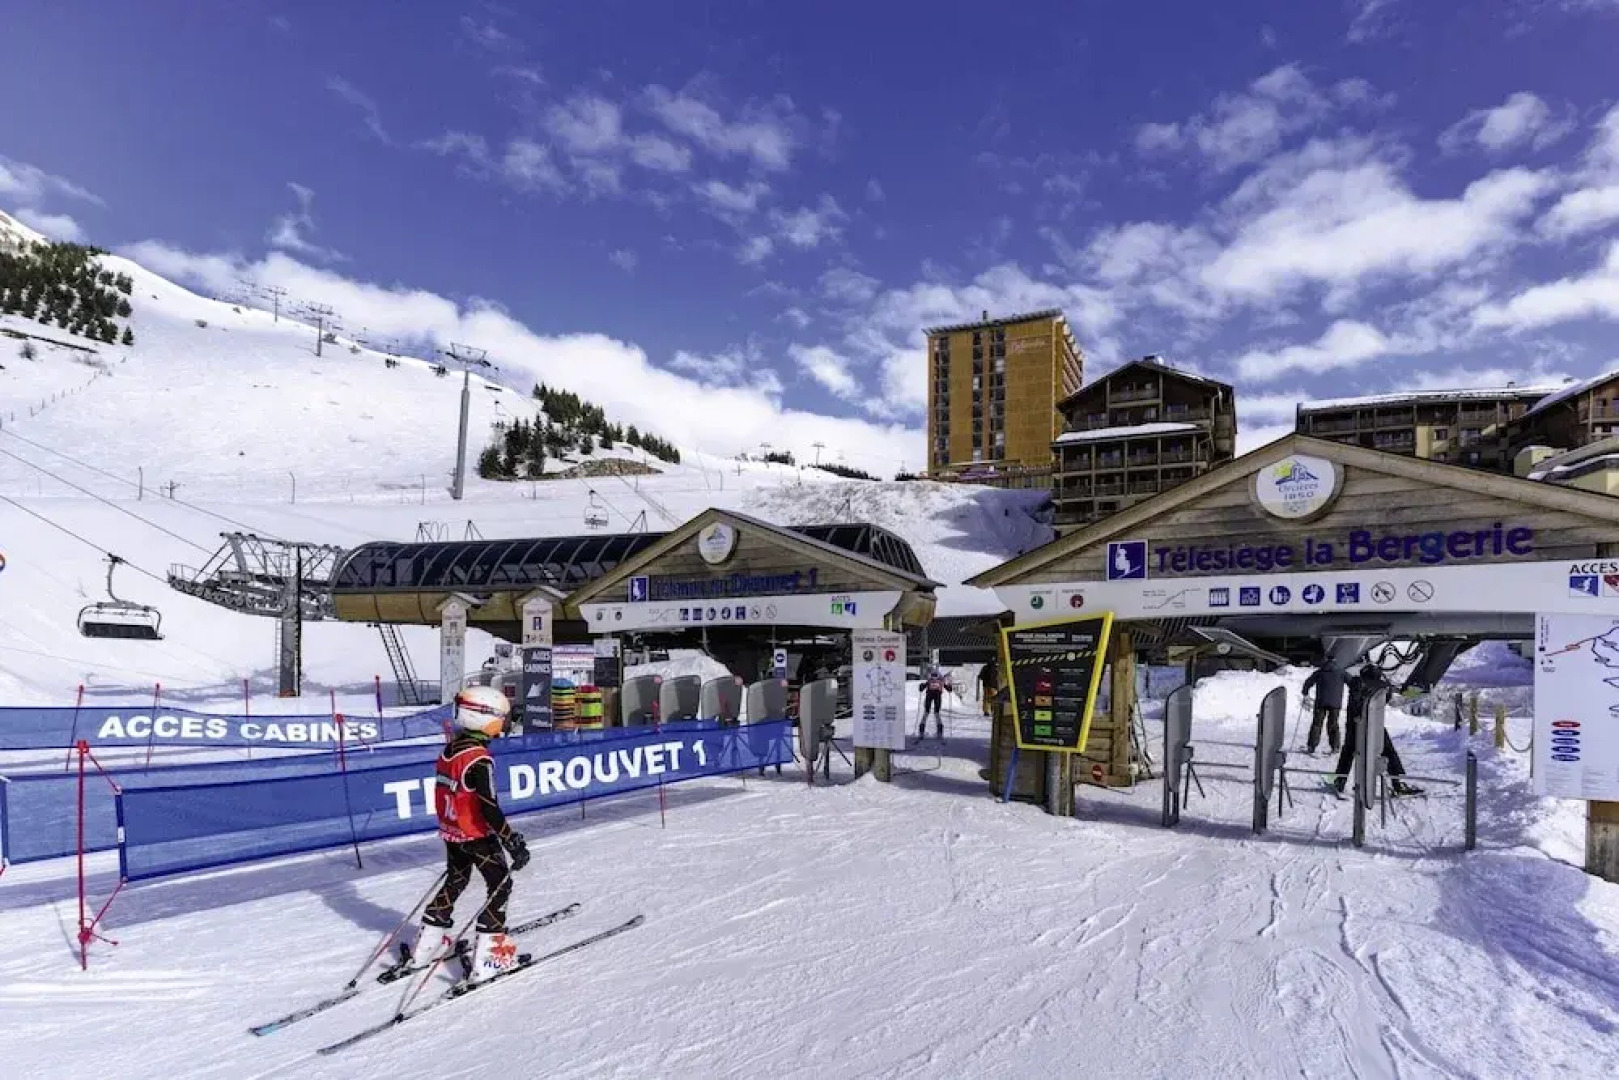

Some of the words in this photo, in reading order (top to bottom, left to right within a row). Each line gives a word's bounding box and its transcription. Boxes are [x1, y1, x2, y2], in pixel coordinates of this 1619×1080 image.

[1155, 544, 1294, 572] Télésiège
[1305, 536, 1334, 565] la
[1350, 522, 1533, 563] Bergerie
[807, 568, 818, 588] 1
[98, 716, 228, 738] ACCES
[240, 721, 378, 742] CABINES
[509, 741, 684, 800] DROUVET
[692, 739, 707, 766] 1
